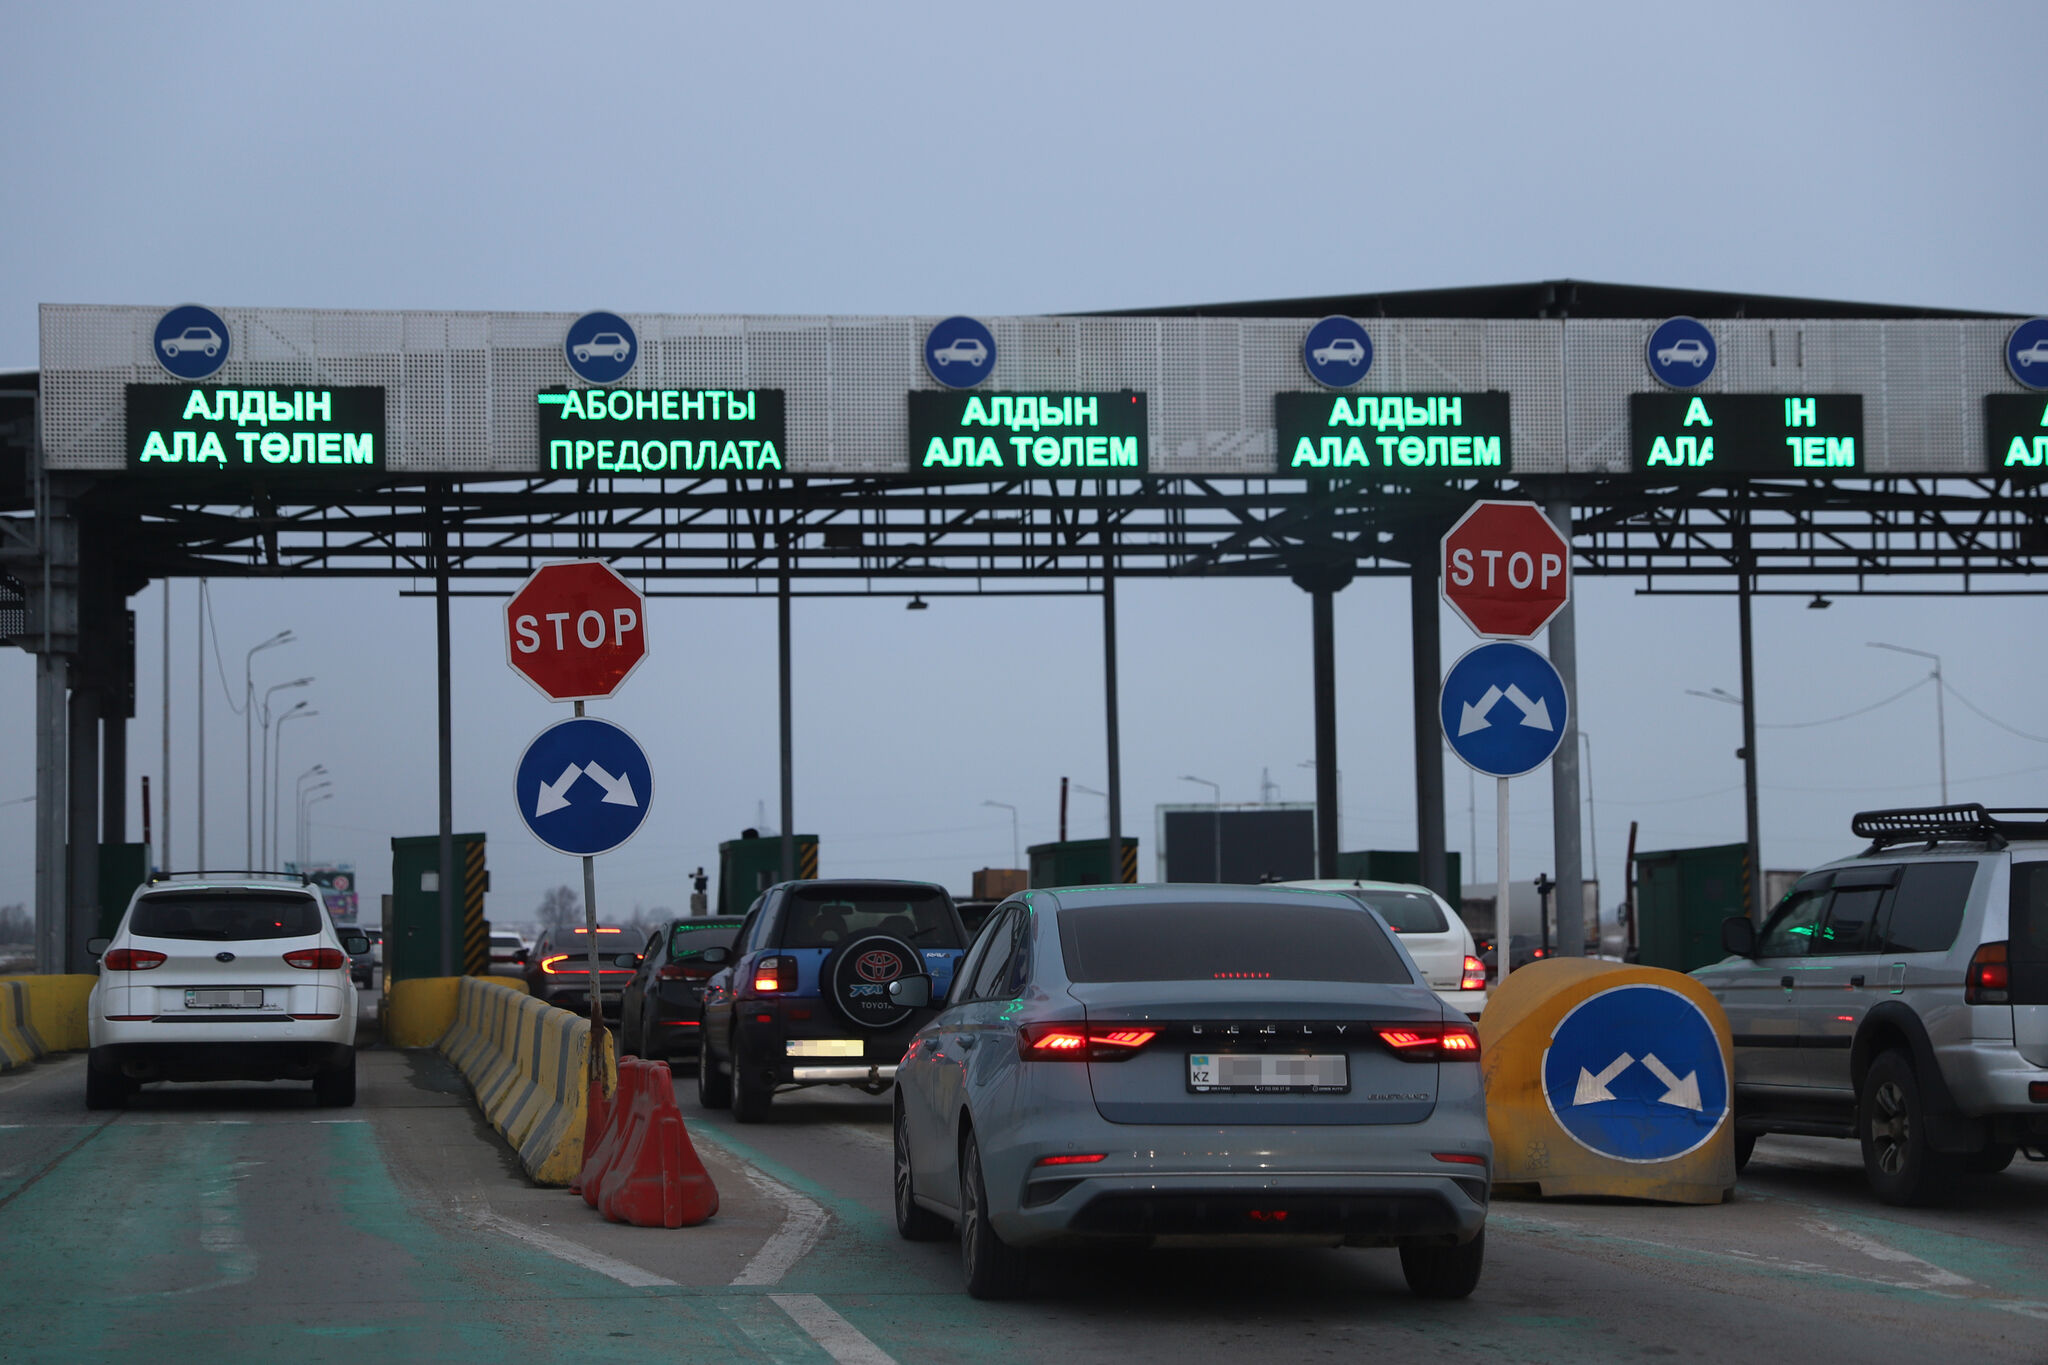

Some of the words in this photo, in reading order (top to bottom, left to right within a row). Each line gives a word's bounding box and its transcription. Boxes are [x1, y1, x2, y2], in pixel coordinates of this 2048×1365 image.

[182, 389, 332, 427] АЛДЫН
[562, 390, 756, 423] АБОНЕНТЫ
[962, 396, 1099, 432] АЛДЫН
[1328, 397, 1463, 432] АЛДЫН
[140, 432, 224, 467] АЛА
[238, 431, 373, 465] ТӨЛЕМ
[550, 438, 782, 472] ПРЕДОПЛАТА
[923, 436, 1004, 467] АЛА
[1010, 436, 1138, 467] ТӨЛЕМ
[1291, 436, 1372, 467] АЛА
[1375, 436, 1501, 467] ТӨЛЕМ
[1451, 548, 1562, 590] STOP
[515, 607, 637, 653] STOP
[1192, 1024, 1347, 1034] GEELY
[1193, 1071, 1209, 1083] KZ
